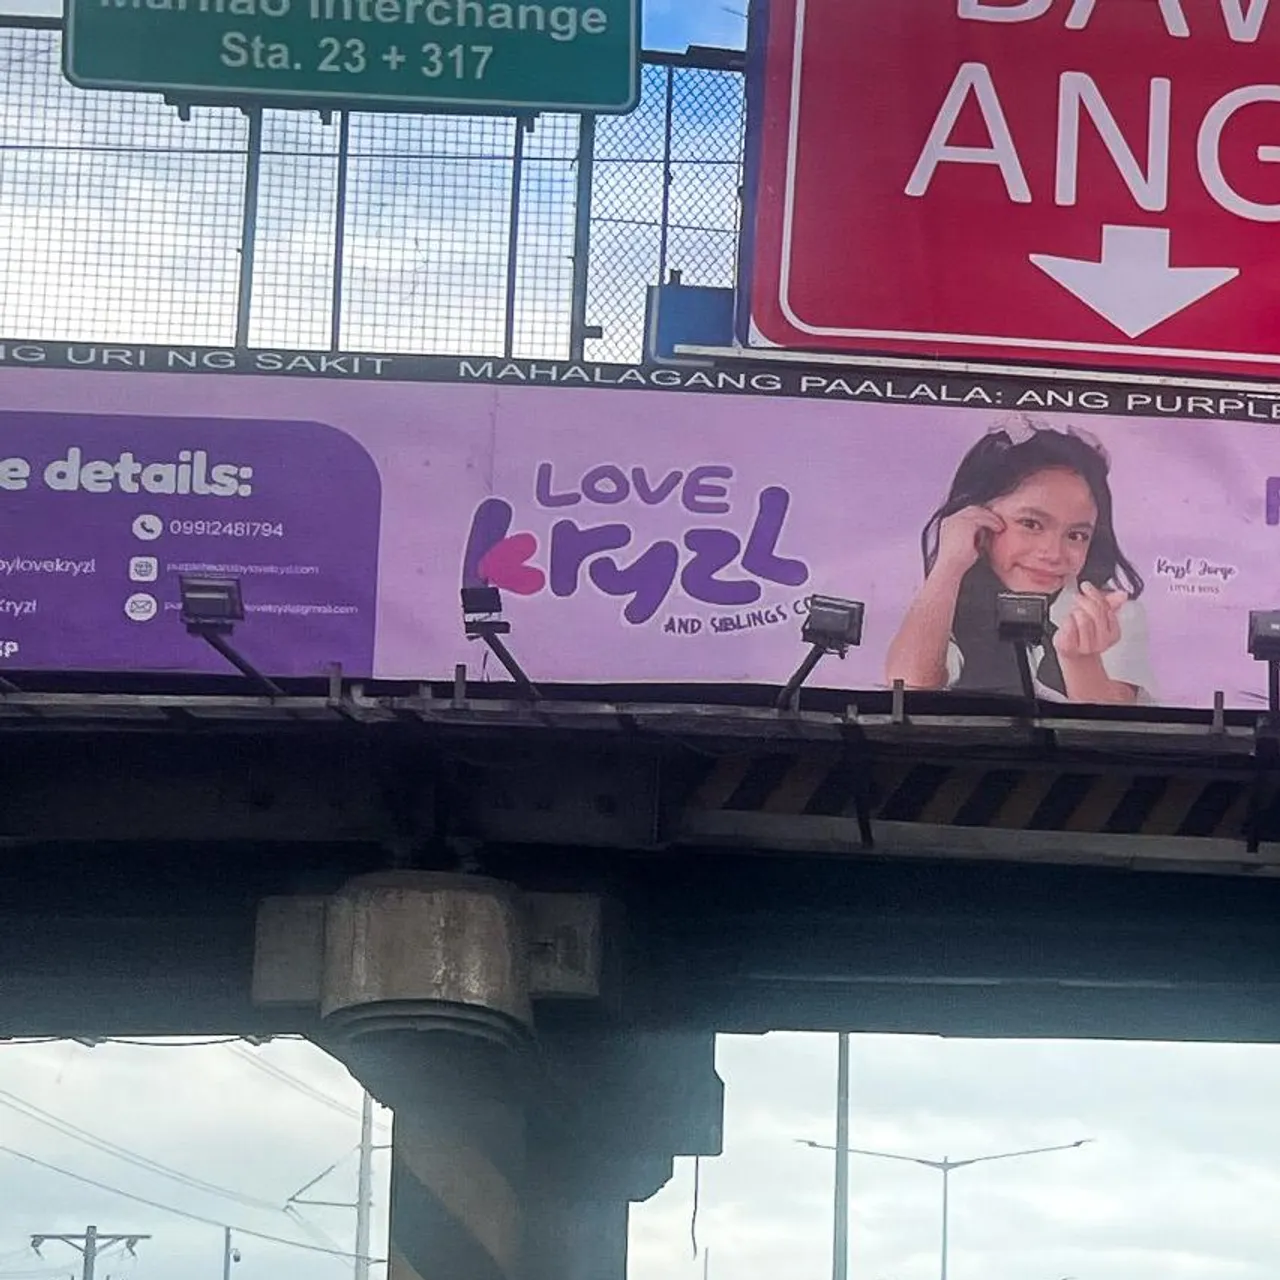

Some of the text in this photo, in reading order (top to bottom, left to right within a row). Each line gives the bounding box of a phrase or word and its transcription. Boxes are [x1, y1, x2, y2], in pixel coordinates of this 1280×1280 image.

[219, 31, 494, 80] Sta. 23 + 317
[66, 345, 147, 367] URI
[167, 349, 238, 370] NG
[255, 351, 393, 375] SAKIT
[458, 360, 783, 391] MAHALAGANG
[800, 375, 1002, 405] PAALALA:
[1015, 389, 1109, 410] ANG
[43, 446, 254, 498] details:
[535, 462, 734, 515] LOVE
[663, 606, 788, 635] AND SIBLINGS
